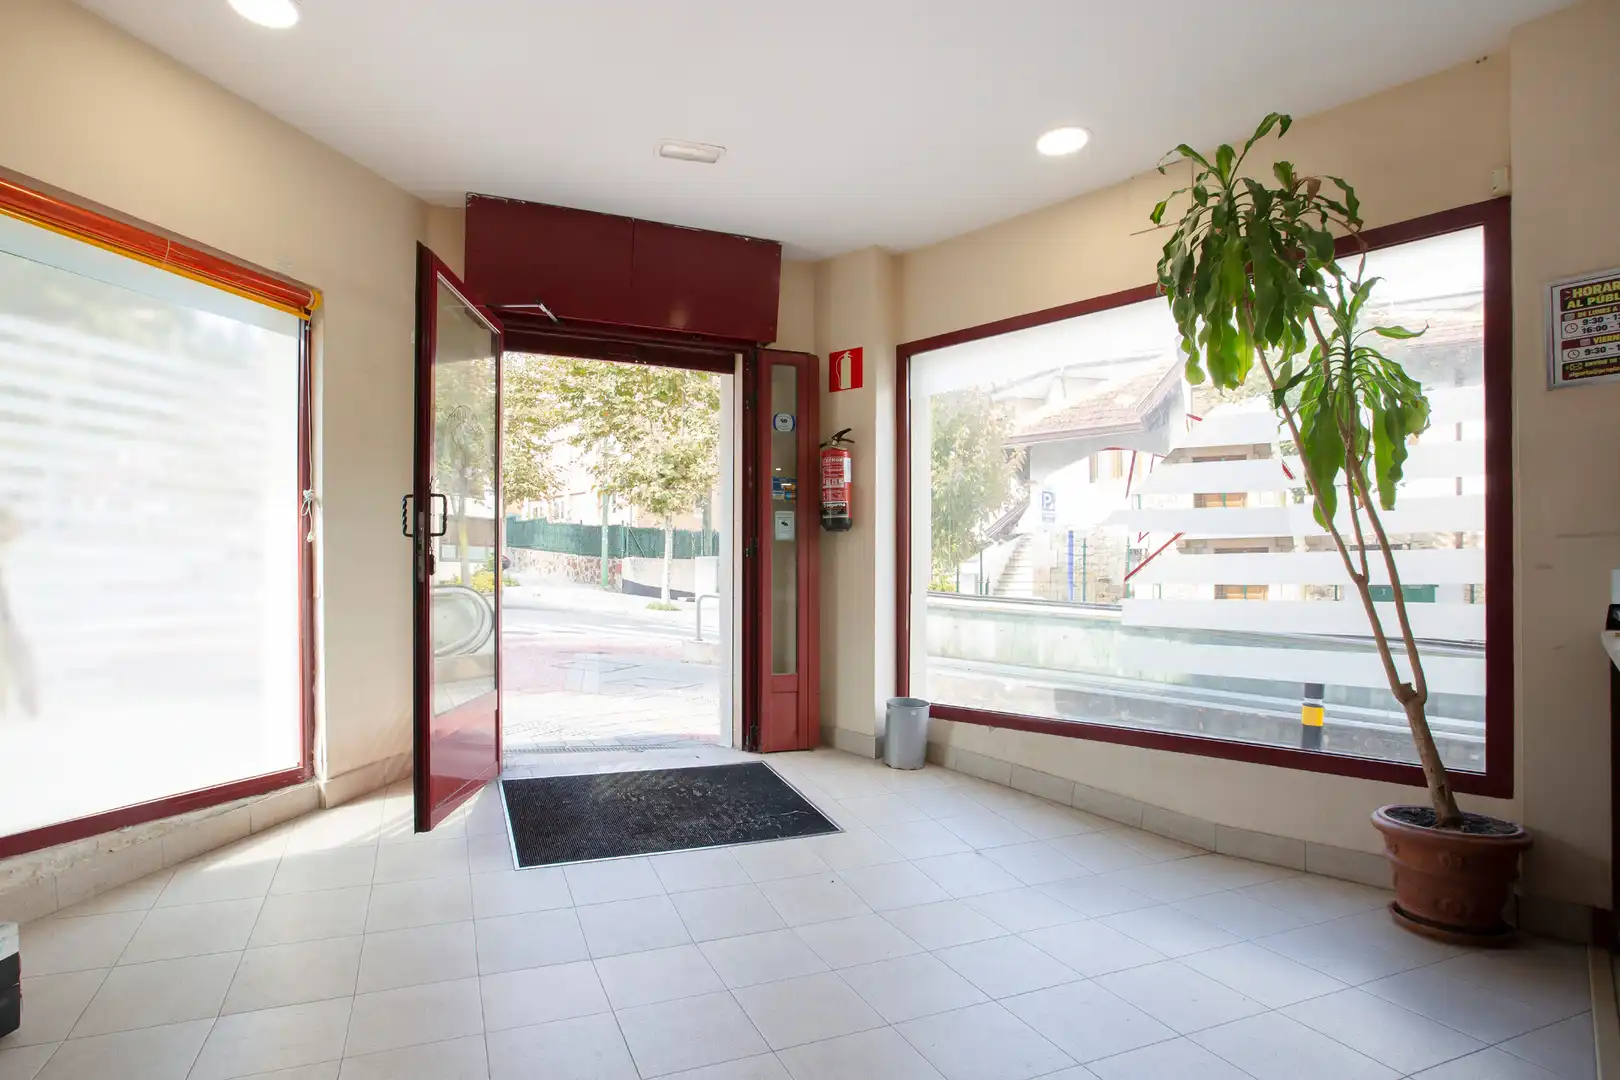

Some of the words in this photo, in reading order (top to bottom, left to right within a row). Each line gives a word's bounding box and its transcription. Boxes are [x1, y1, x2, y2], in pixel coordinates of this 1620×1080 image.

[1567, 299, 1583, 309] AL
[1582, 316, 1604, 326] 9:30
[1582, 324, 1608, 334] 16:00
[1584, 346, 1606, 356] 9:30
